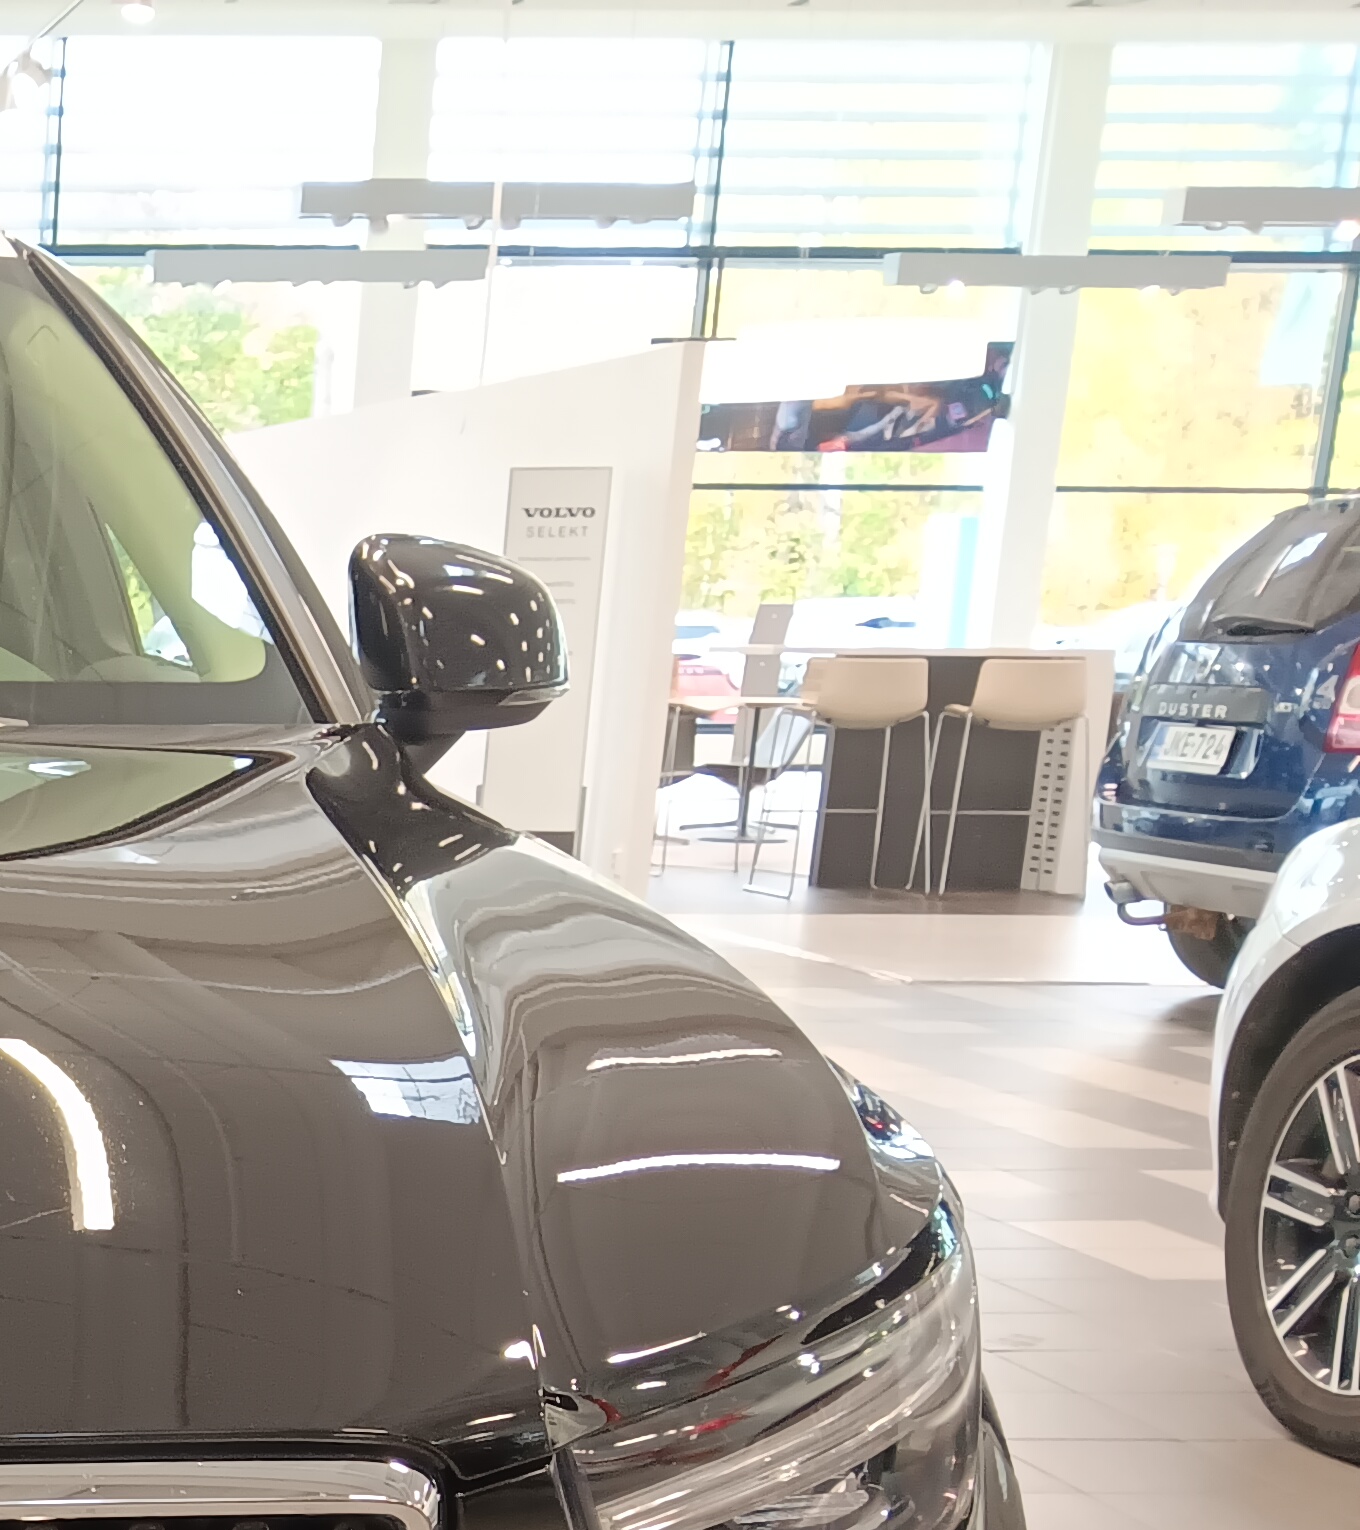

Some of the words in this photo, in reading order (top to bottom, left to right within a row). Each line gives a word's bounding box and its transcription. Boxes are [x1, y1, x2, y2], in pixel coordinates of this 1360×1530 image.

[522, 506, 596, 518] VOLVO
[526, 525, 588, 538] SELEKT
[1158, 702, 1227, 719] DUSTER
